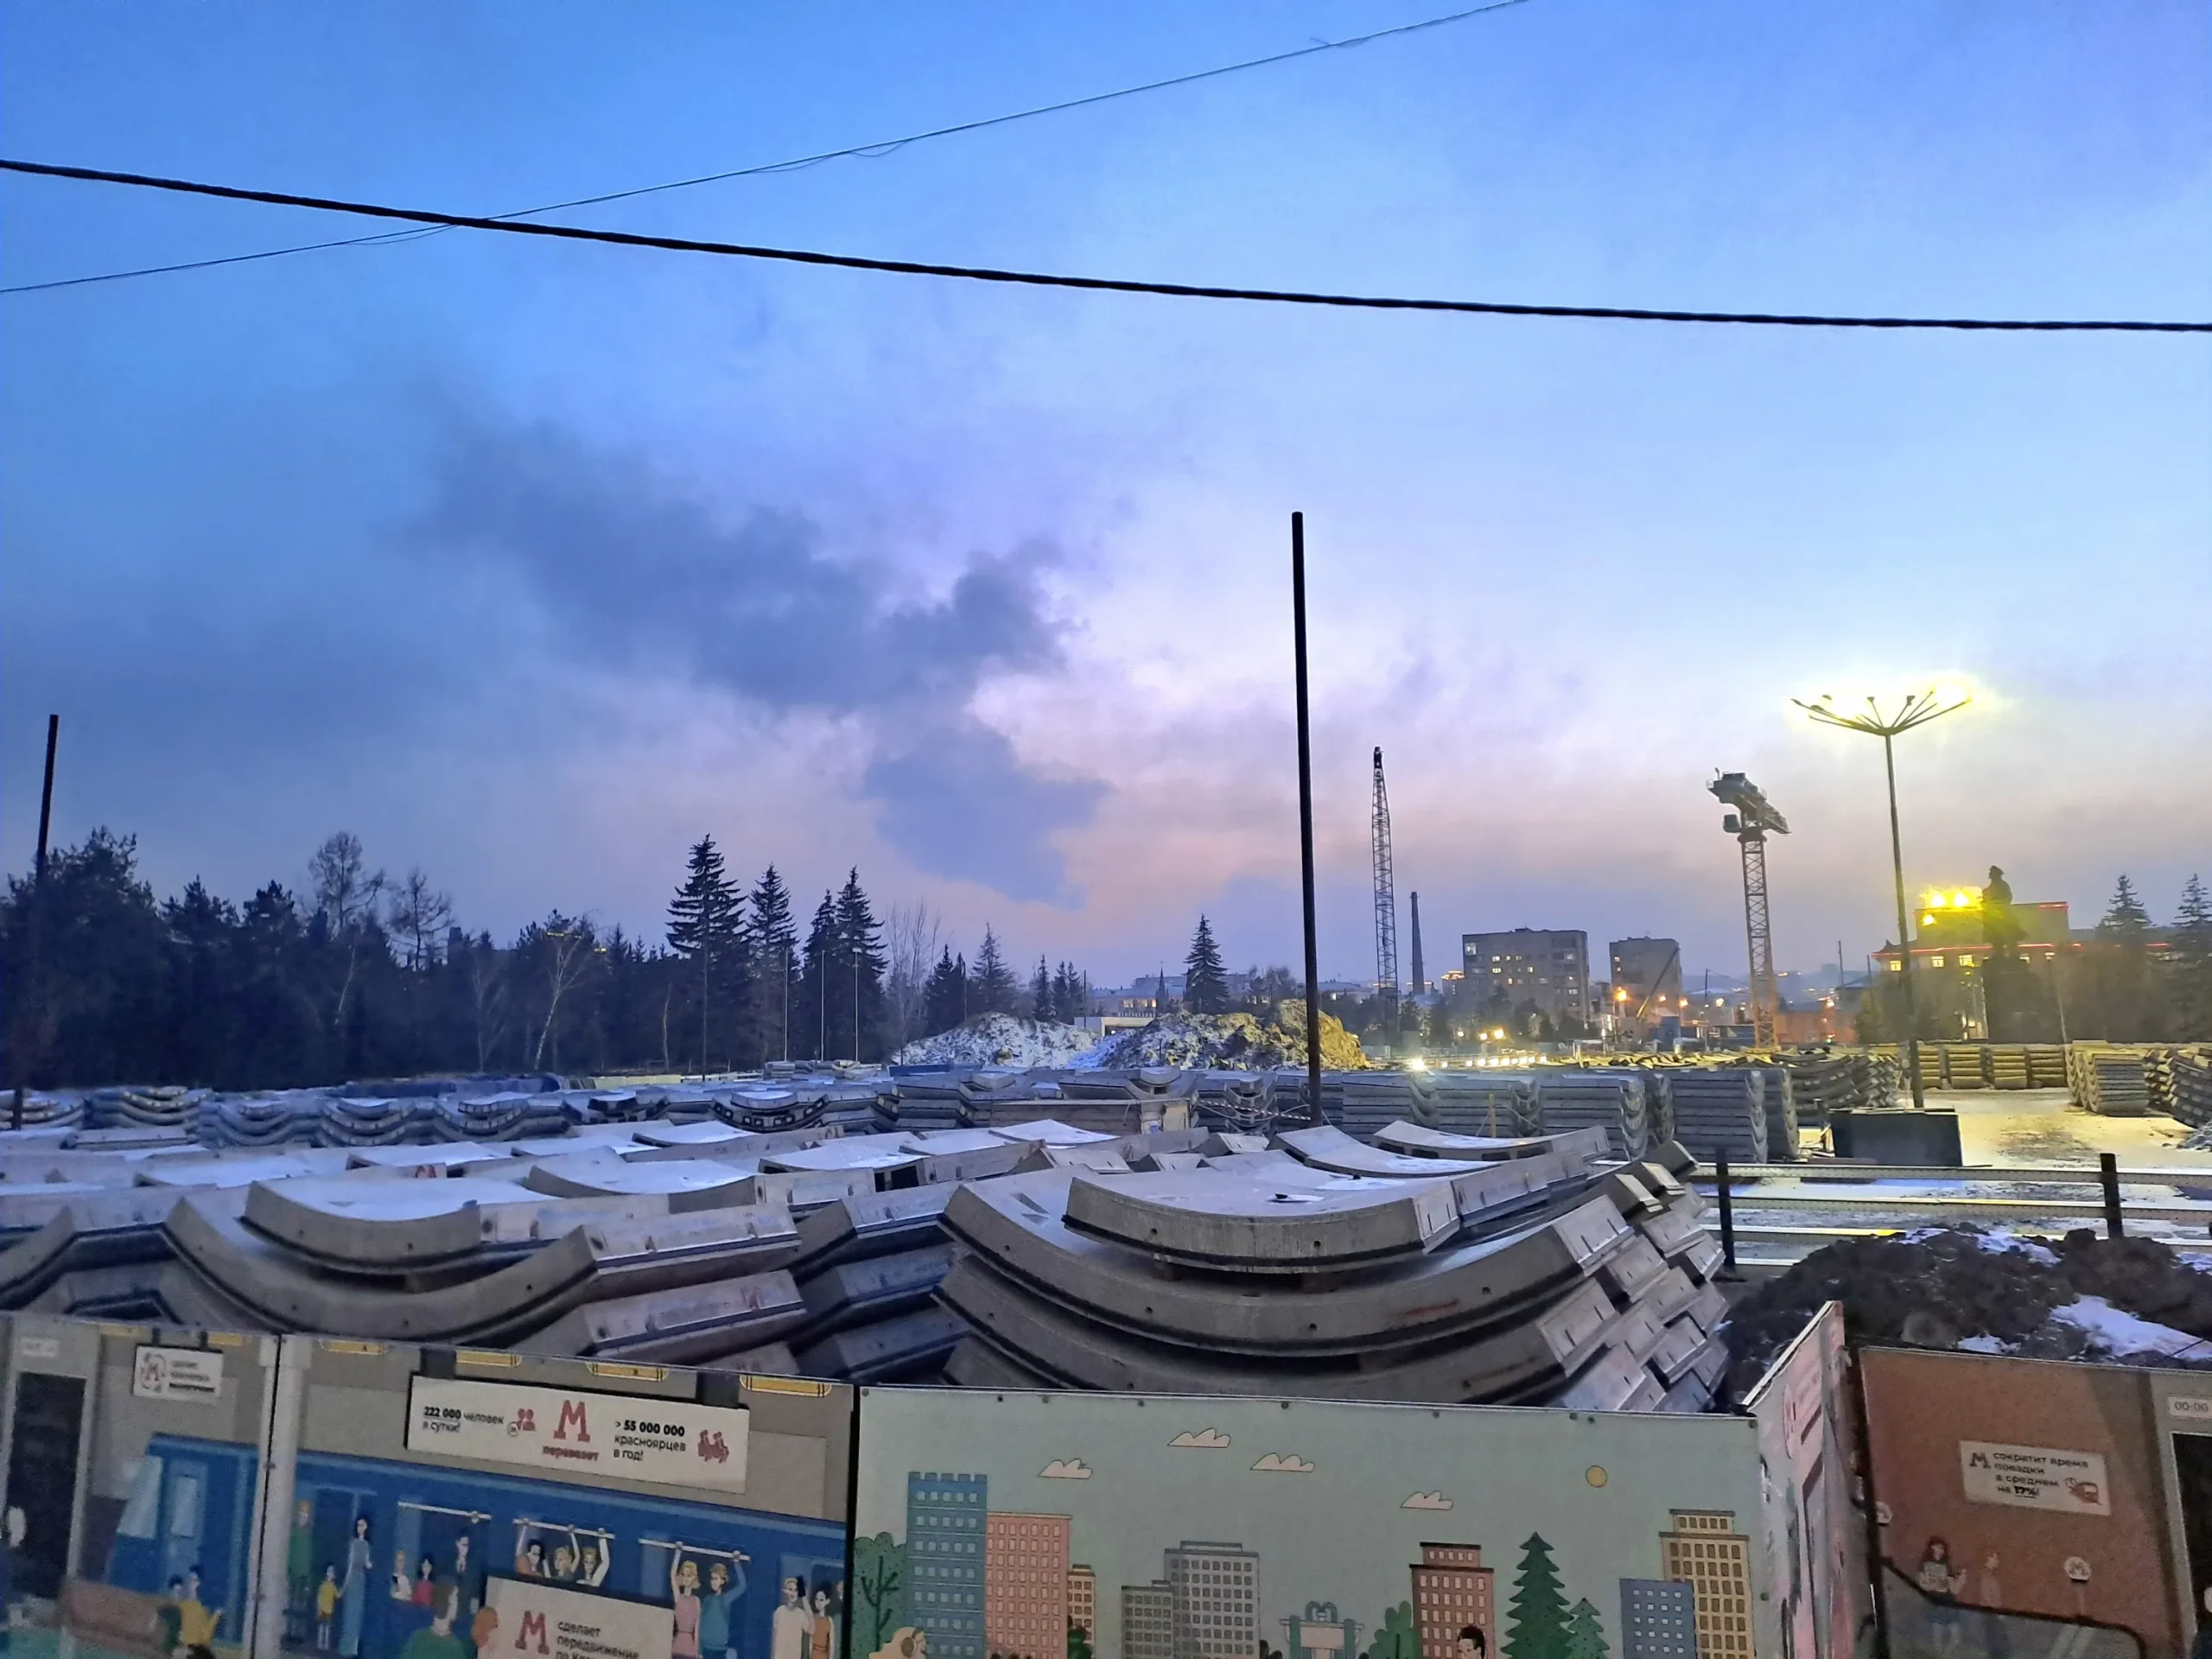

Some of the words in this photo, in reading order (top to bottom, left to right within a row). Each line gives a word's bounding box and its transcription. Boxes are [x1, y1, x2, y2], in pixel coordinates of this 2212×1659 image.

[424, 1406, 441, 1418] 222
[442, 1408, 461, 1420] 000
[463, 1412, 505, 1425] человек
[624, 1420, 638, 1432] 55
[639, 1422, 661, 1434] 000
[664, 1424, 685, 1437] 000
[614, 1433, 687, 1453] красноярцев
[613, 1448, 620, 1459] в
[622, 1450, 644, 1462] год!
[1993, 1452, 2047, 1465] сократит
[2005, 1475, 2061, 1487] среднем
[557, 1620, 601, 1638] сделает
[556, 1635, 639, 1659] передвижение
